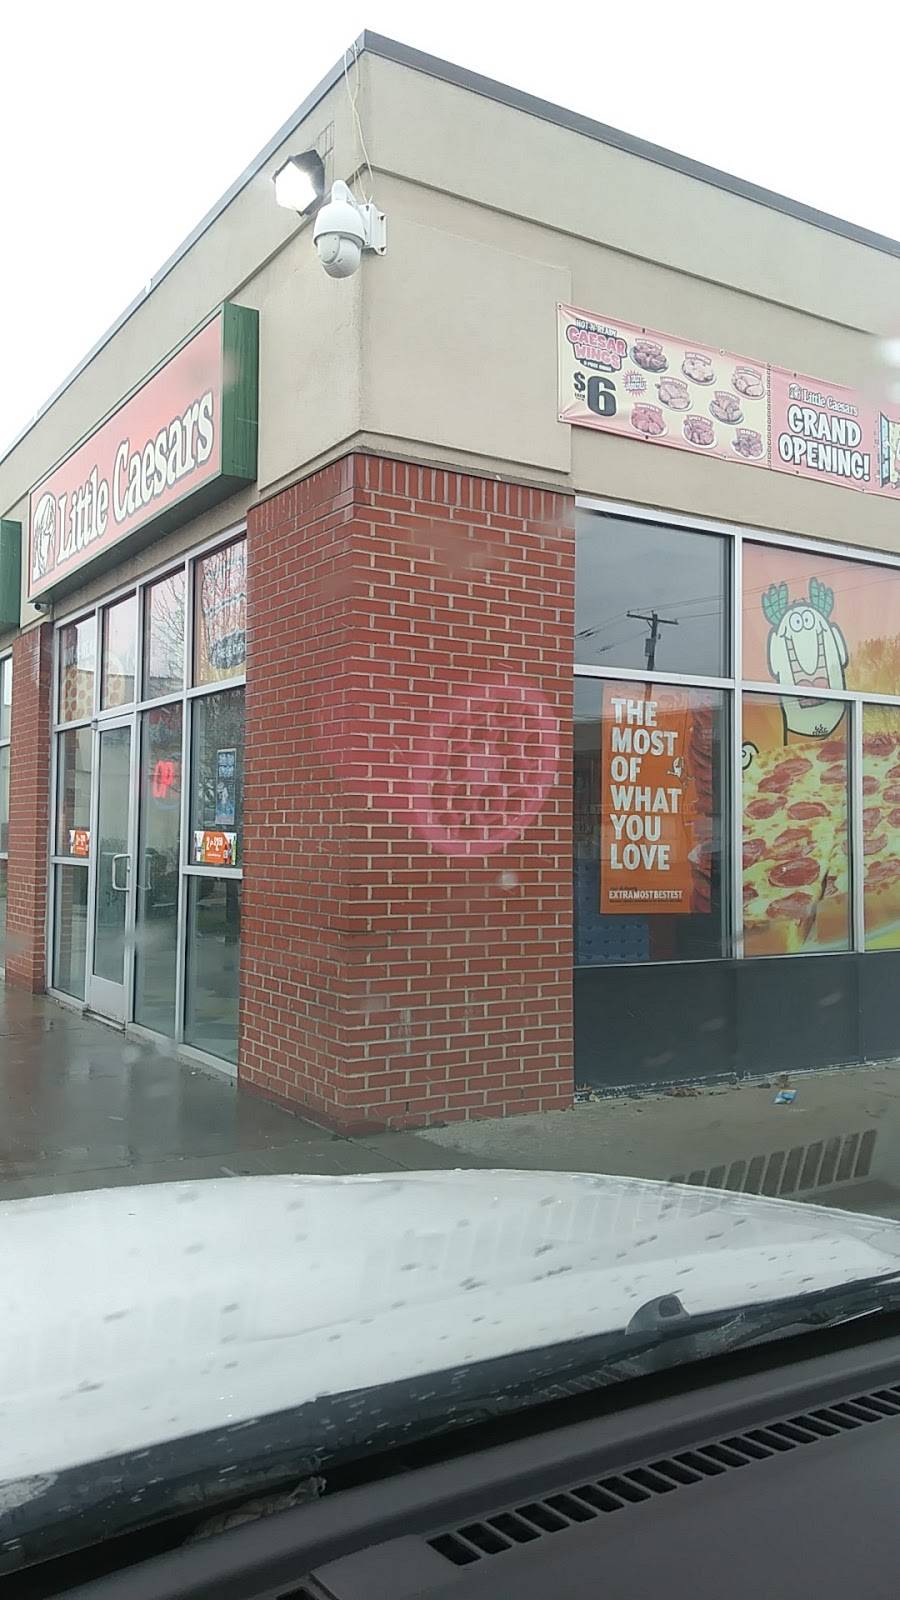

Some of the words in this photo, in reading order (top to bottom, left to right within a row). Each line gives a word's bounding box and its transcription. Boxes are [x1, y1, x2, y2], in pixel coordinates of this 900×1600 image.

[567, 325, 627, 357] CAESAR
[574, 343, 621, 370] WINGS
[803, 389, 826, 408] Little
[827, 396, 858, 417] Caesars
[788, 404, 861, 448] GRAND
[778, 433, 870, 481] OPENING!
[56, 466, 108, 564] Little
[113, 391, 214, 525] Caesars
[611, 697, 658, 727] THE
[611, 727, 678, 757] MOST
[611, 756, 641, 783] OF
[610, 785, 682, 814] WHAT
[610, 814, 661, 842] YOU
[611, 843, 671, 871] LOVE
